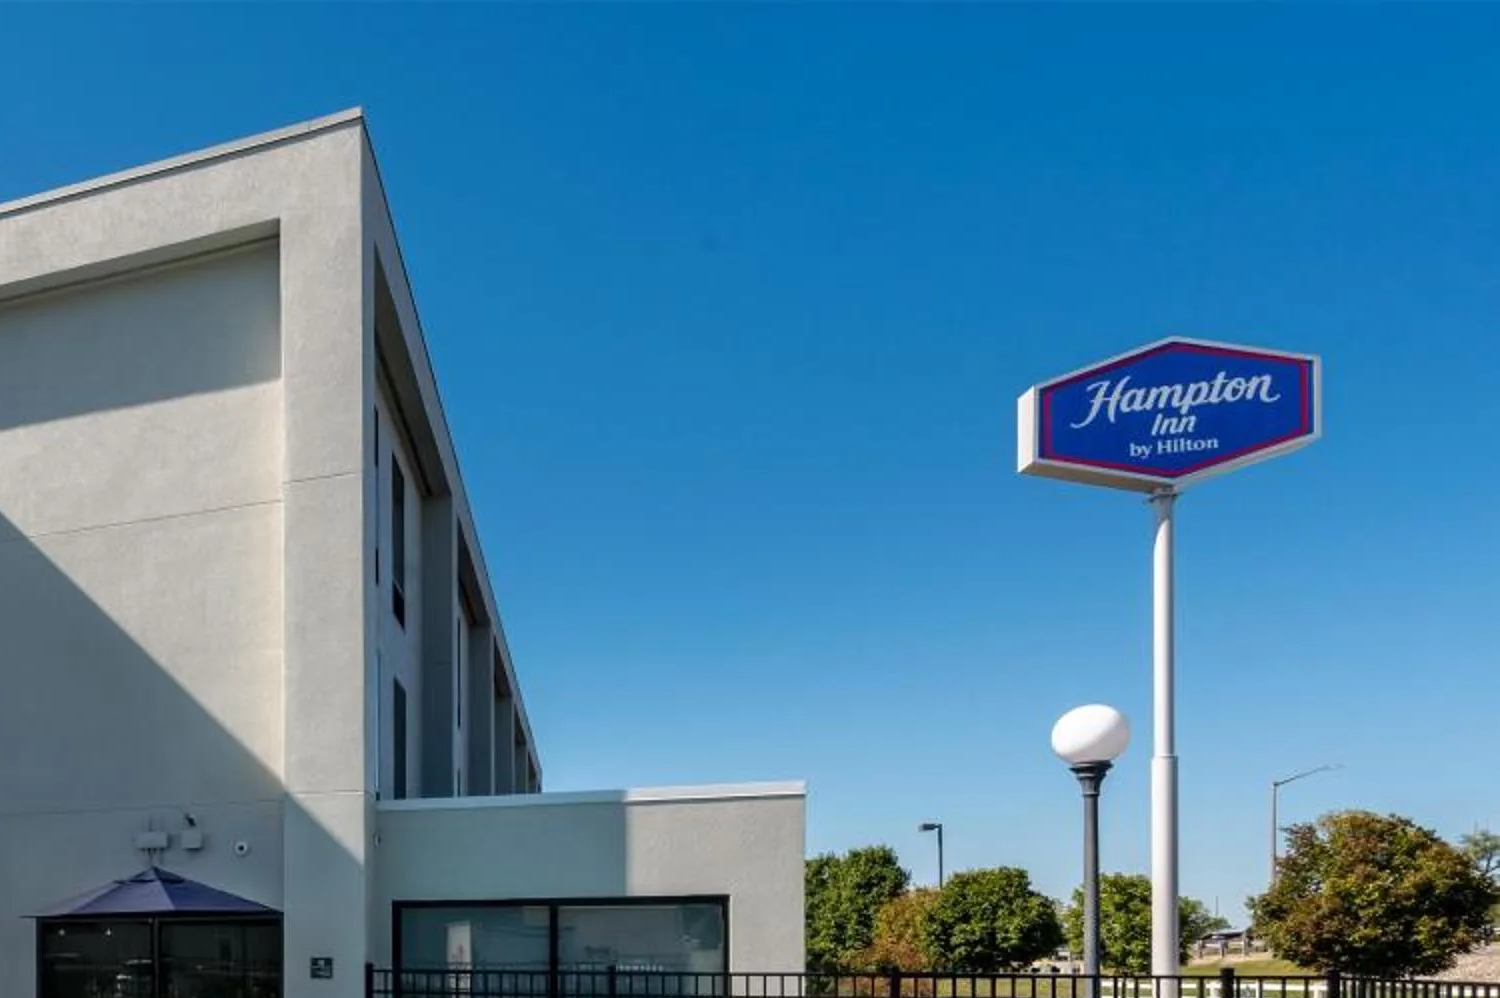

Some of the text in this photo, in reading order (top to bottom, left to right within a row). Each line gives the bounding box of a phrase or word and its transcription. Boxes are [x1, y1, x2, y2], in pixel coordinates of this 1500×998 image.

[1070, 371, 1281, 429] Hampton
[1151, 413, 1197, 437] Inn
[1129, 437, 1219, 460] by Hilton
